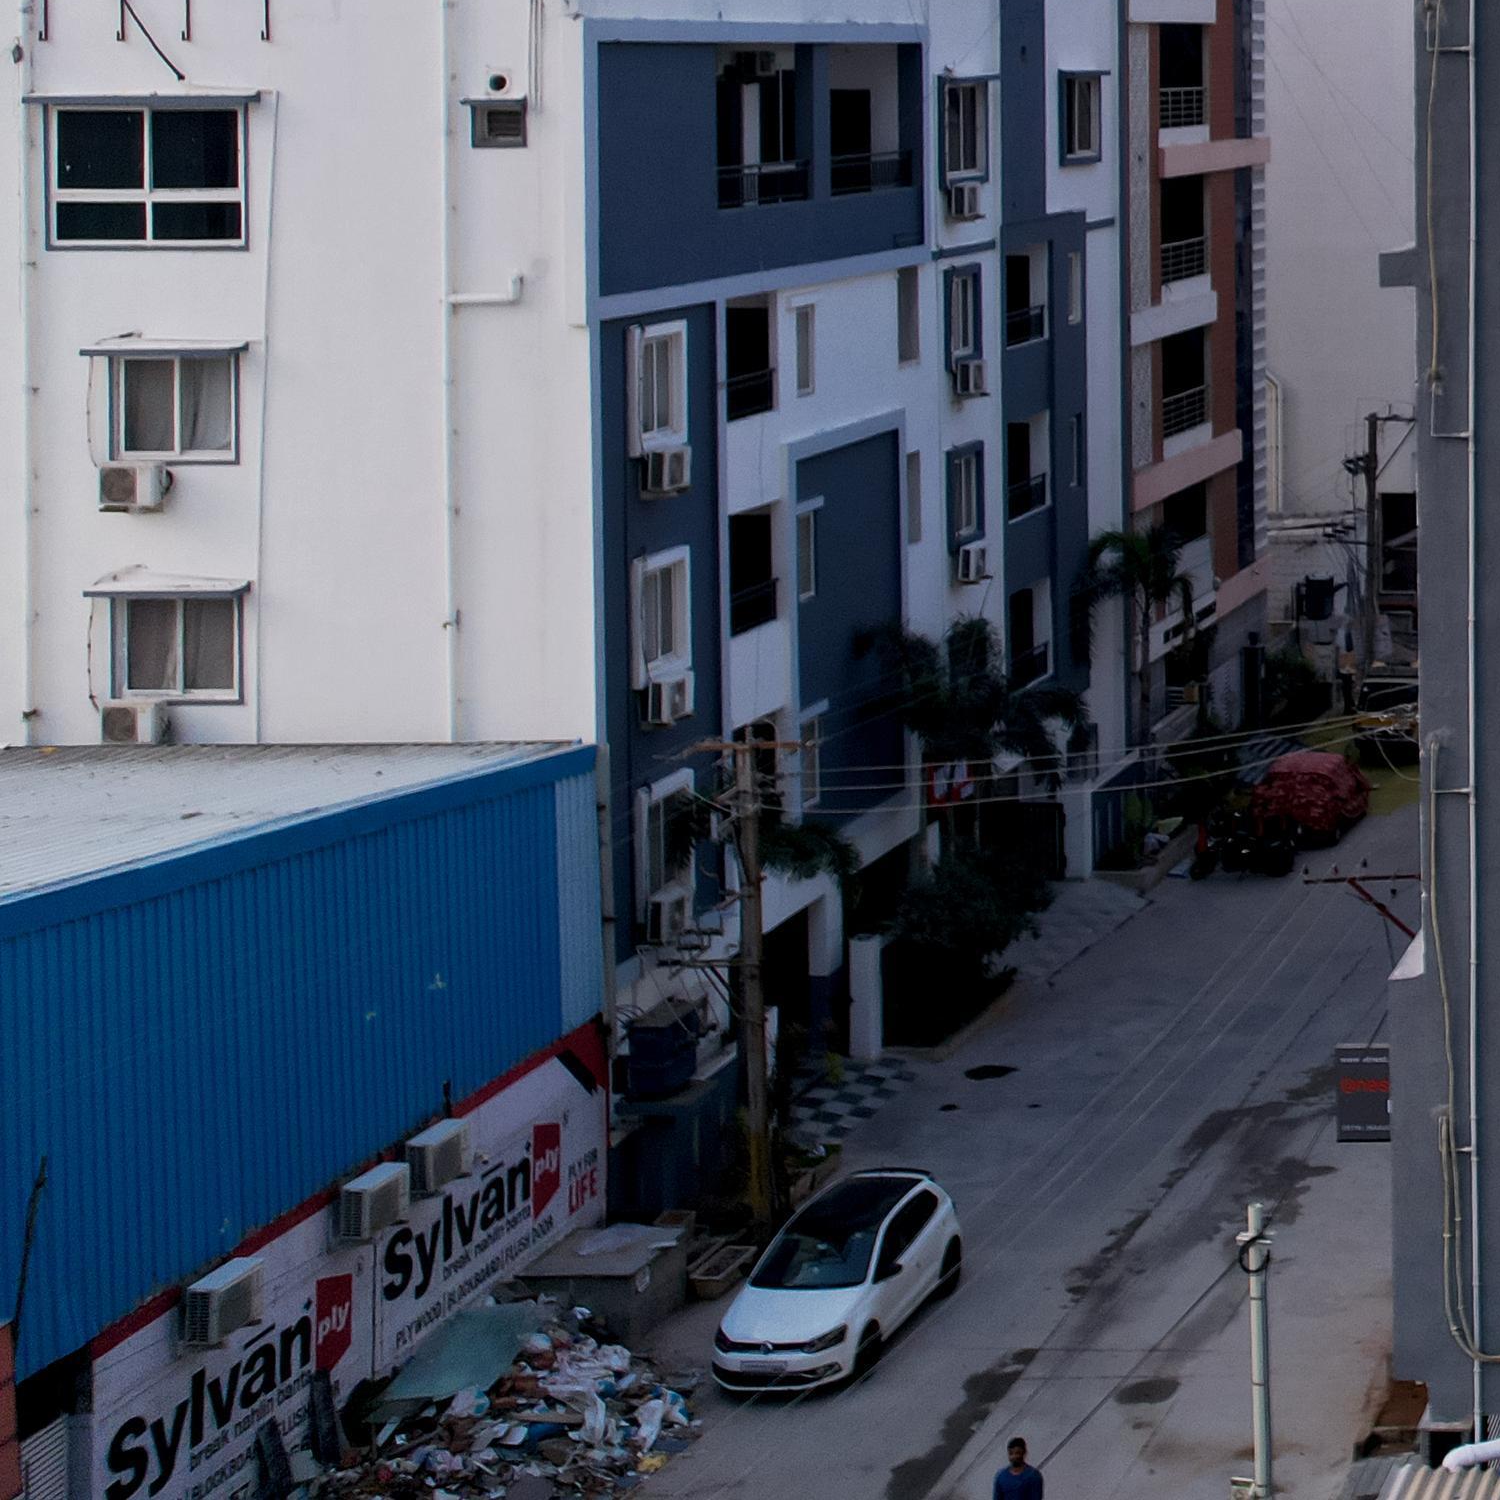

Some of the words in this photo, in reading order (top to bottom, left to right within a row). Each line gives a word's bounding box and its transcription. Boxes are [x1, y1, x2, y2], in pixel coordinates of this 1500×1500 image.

[534, 1148, 559, 1183] ply
[568, 1167, 599, 1216] LIFE
[317, 1301, 351, 1344] ply
